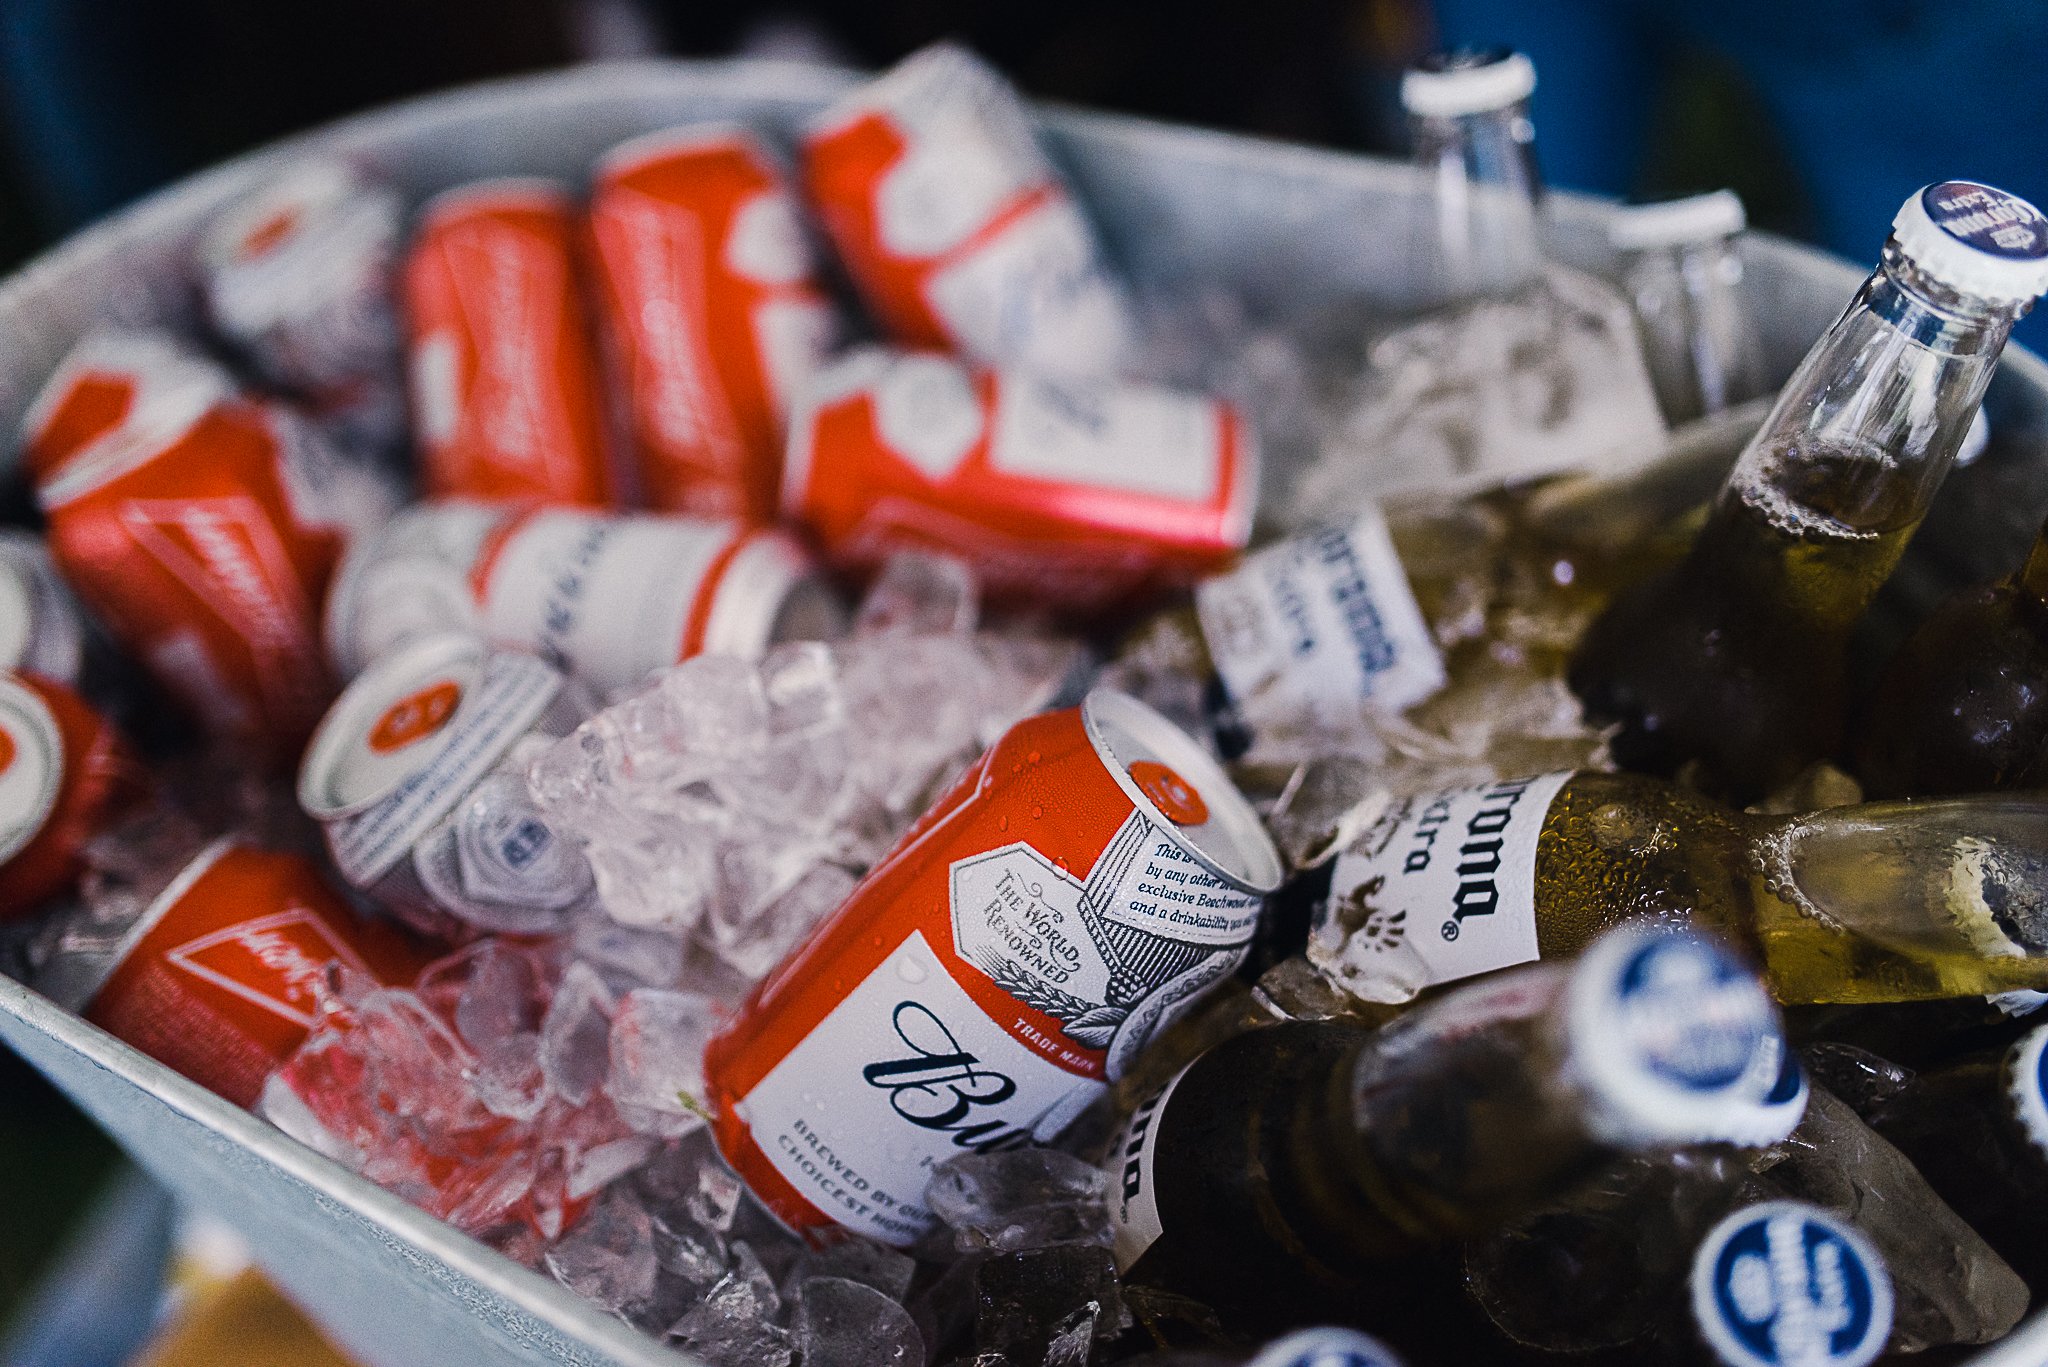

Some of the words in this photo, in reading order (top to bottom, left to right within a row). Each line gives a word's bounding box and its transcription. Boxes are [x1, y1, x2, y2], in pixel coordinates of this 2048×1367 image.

[1145, 862, 1162, 879] by
[1164, 869, 1188, 886] any
[1189, 873, 1220, 888] other
[1154, 843, 1181, 860] This
[1403, 792, 1452, 875] xtra
[1452, 779, 1532, 924] rona
[995, 867, 1024, 912] THE
[1024, 901, 1081, 972] WORLD
[1129, 900, 1157, 916] and
[1158, 909, 1168, 919] a
[1170, 909, 1228, 931] drinkability
[1138, 881, 1195, 904] exclusive
[983, 897, 1069, 984] RENOWNED
[863, 1000, 1030, 1153] Bu
[1013, 1017, 1060, 1053] TRADE
[778, 1134, 870, 1217] CHOICEST
[793, 1118, 869, 1192] BREWED
[870, 1189, 896, 1208] BY
